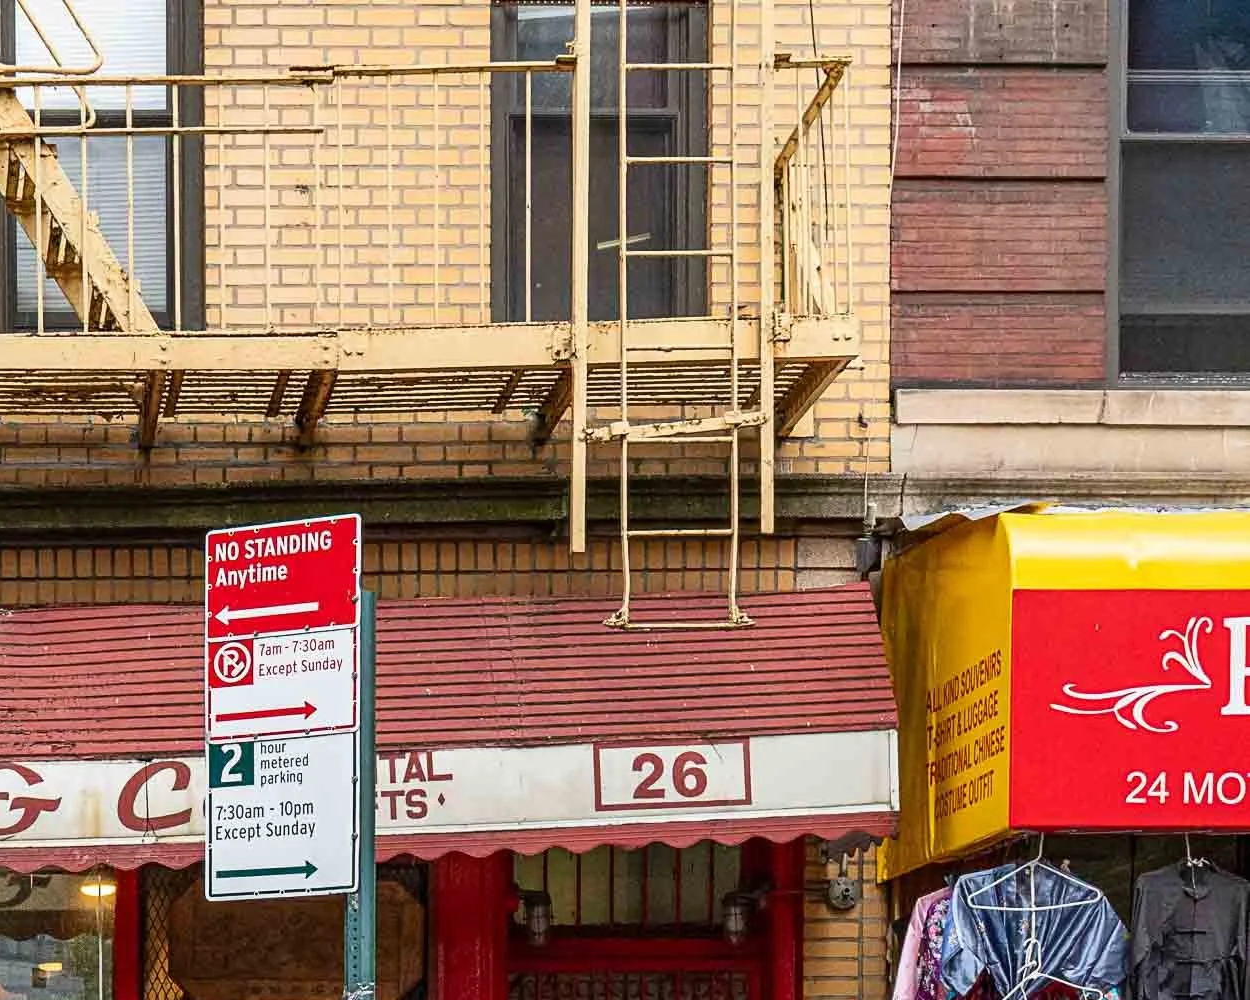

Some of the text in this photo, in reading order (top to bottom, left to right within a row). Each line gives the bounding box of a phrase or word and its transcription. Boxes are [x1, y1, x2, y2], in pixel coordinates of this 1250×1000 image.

[215, 530, 332, 563] NO STANDING
[215, 562, 289, 588] Anytime
[258, 643, 282, 657] 7am
[292, 637, 336, 654] 7:30am
[258, 656, 344, 678] Except Sunday
[926, 650, 1002, 713] ALL KIND SOUVENIRS
[963, 690, 999, 733] LUGGAGE
[221, 742, 286, 783] 2 hour
[260, 754, 309, 770] metered
[375, 751, 454, 784] TAL
[926, 725, 1005, 787] TRADITIONAL CHINESE
[260, 770, 303, 786] parking
[631, 751, 708, 800] 26
[968, 769, 994, 806] OUTFIT
[1125, 771, 1250, 805] 24 MO
[117, 760, 206, 832] C
[215, 804, 265, 821] 7:30am
[279, 801, 314, 819] 10pm
[375, 790, 428, 820] TS
[215, 821, 316, 843] Except Sunday
